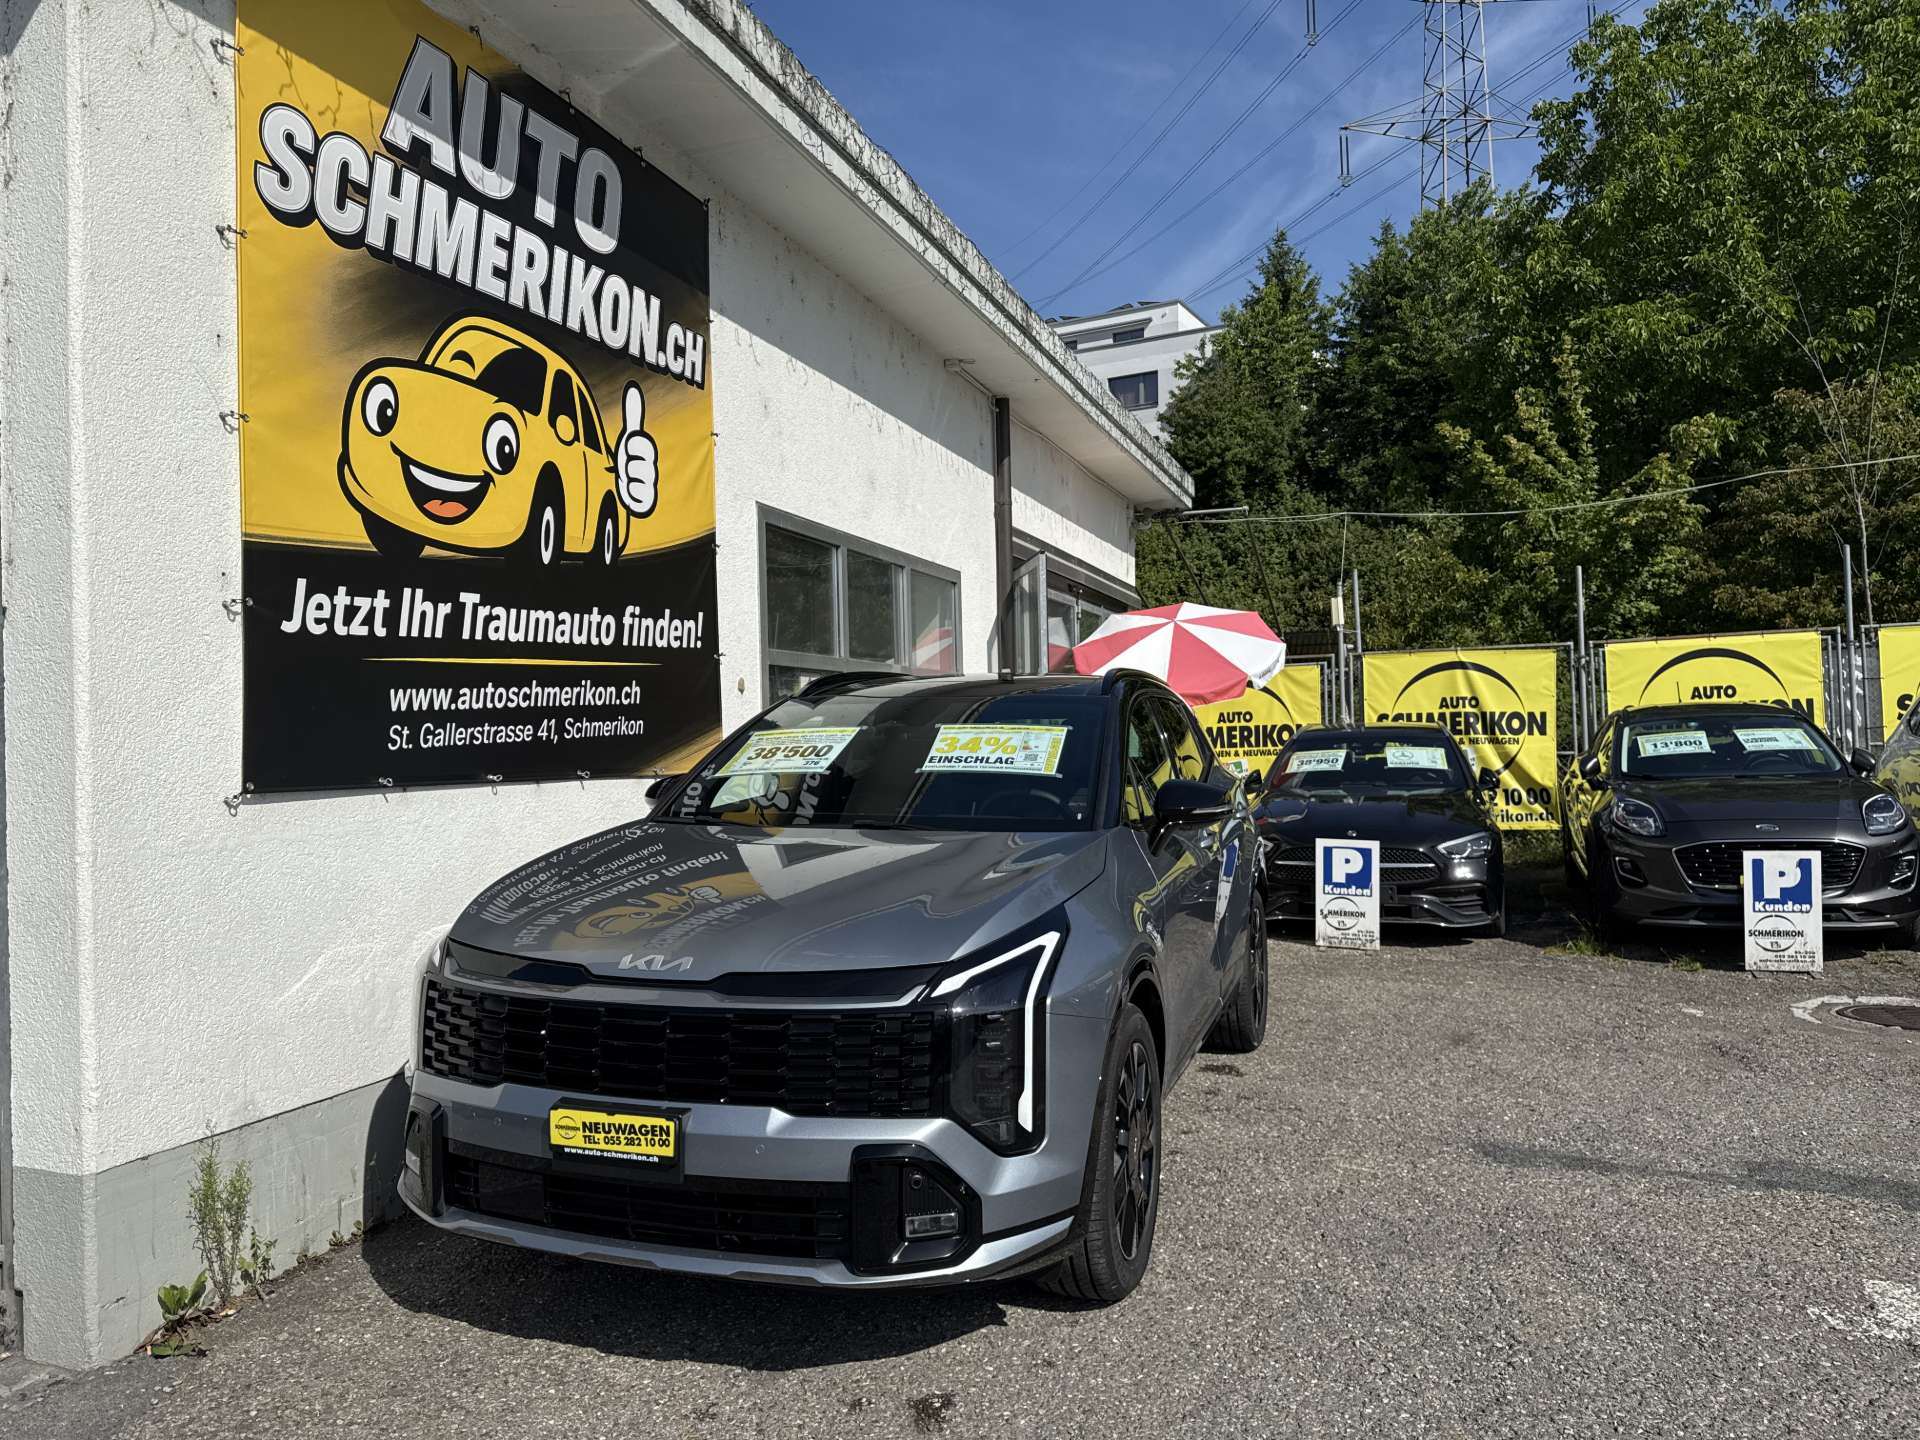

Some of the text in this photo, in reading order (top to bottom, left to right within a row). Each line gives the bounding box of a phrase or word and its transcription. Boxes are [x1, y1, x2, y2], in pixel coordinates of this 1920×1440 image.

[382, 35, 622, 254] AUTO
[254, 104, 705, 385] SCHMERIKON.CH
[281, 578, 703, 649] Jetzt Ihr Traumauto finden!
[389, 680, 644, 711] www.autoschmerikon.ch
[1691, 685, 1737, 700] AUTO
[1439, 695, 1480, 710] AUTO
[1217, 711, 1253, 724] AUTO
[388, 717, 644, 750] St. Gallerstrasse 41, Schmerikon
[1458, 737, 1520, 745] & NEUWAGEN
[935, 735, 1018, 754] 34%
[747, 745, 834, 760] 38'500
[928, 755, 1016, 765] EINSCHLAG
[1502, 788, 1522, 806] 10
[1526, 787, 1552, 805] 00
[1332, 848, 1364, 883] P
[1764, 857, 1801, 899] P
[1324, 885, 1371, 897] Kunden
[1755, 901, 1811, 912] Kunden
[1748, 929, 1805, 938] SCHMERIKON
[582, 1121, 671, 1137] NEUWAGEN
[583, 1135, 671, 1148] TEL: 055 282 10 00
[564, 1147, 659, 1162] www.auto-schmerikon.ch
